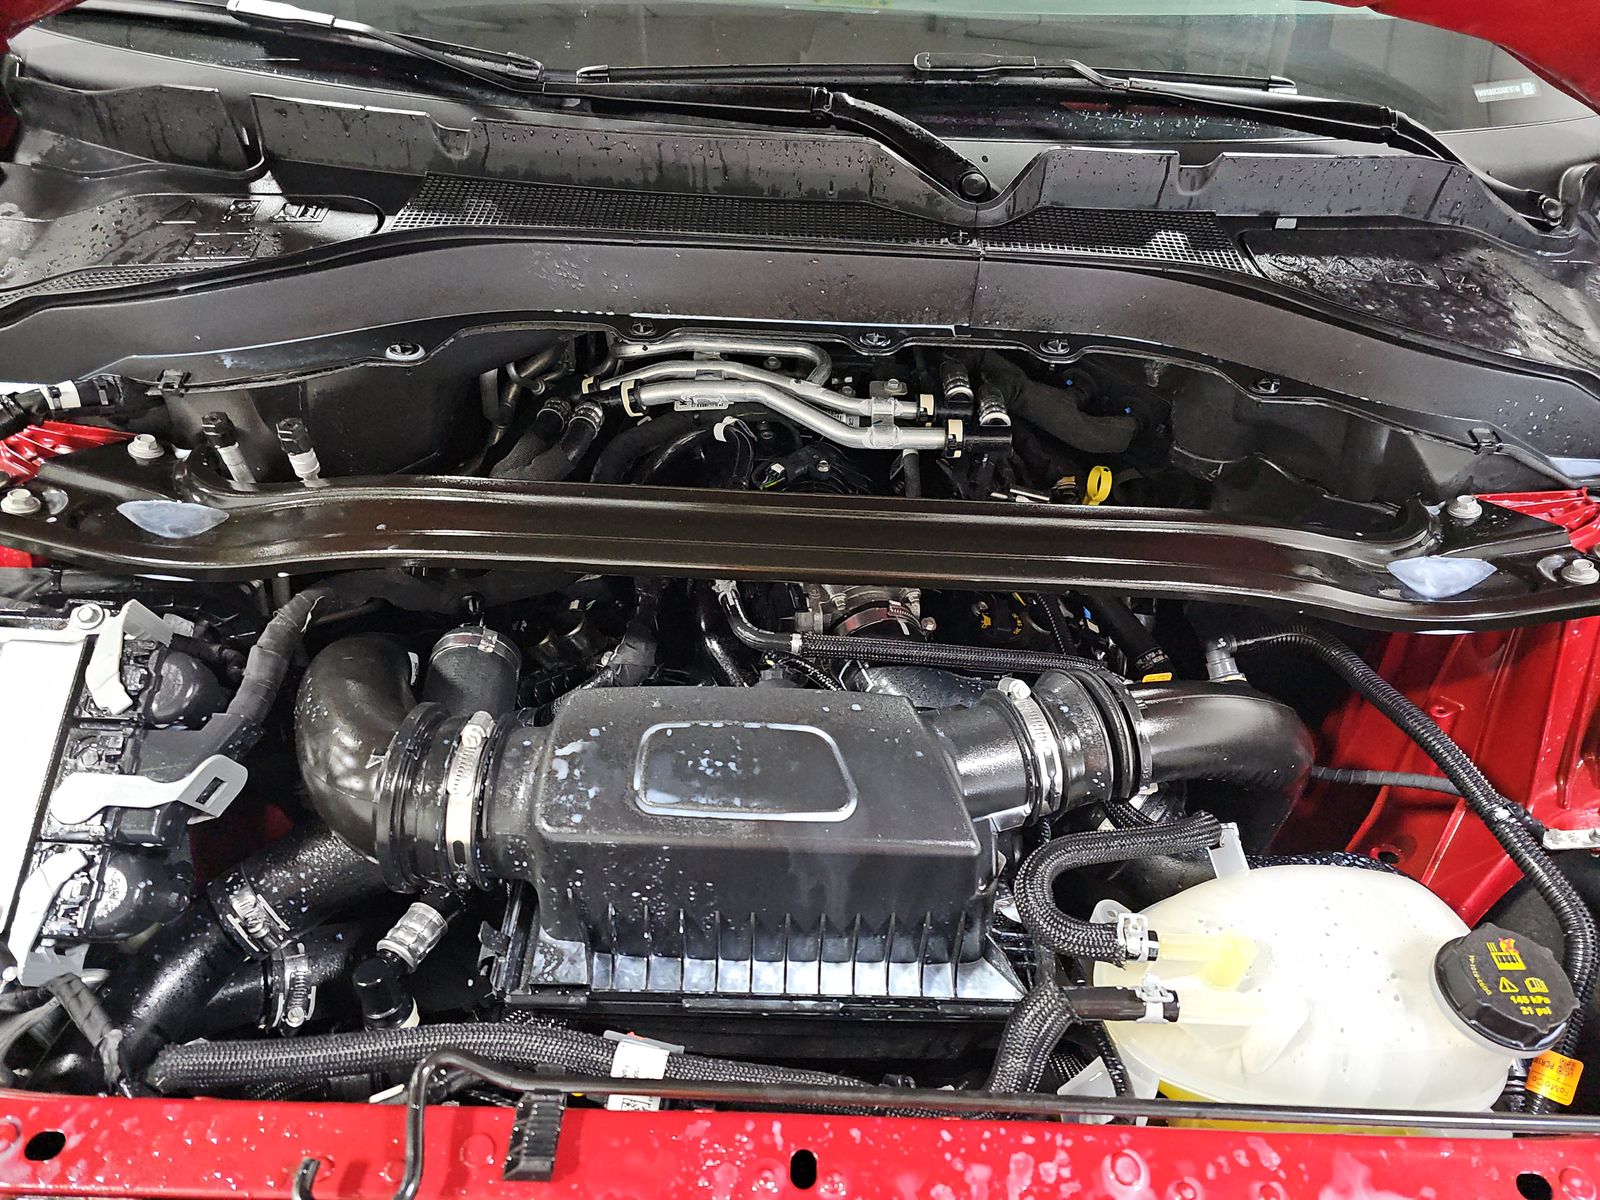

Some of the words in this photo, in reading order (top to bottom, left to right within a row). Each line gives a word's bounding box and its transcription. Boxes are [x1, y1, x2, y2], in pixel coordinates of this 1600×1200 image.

[1509, 995, 1529, 1005] 145
[1529, 995, 1551, 1005] kPa
[1520, 1006, 1534, 1015] 21
[1535, 1006, 1552, 1017] psi
[1531, 1075, 1569, 1097] FoMoCo
